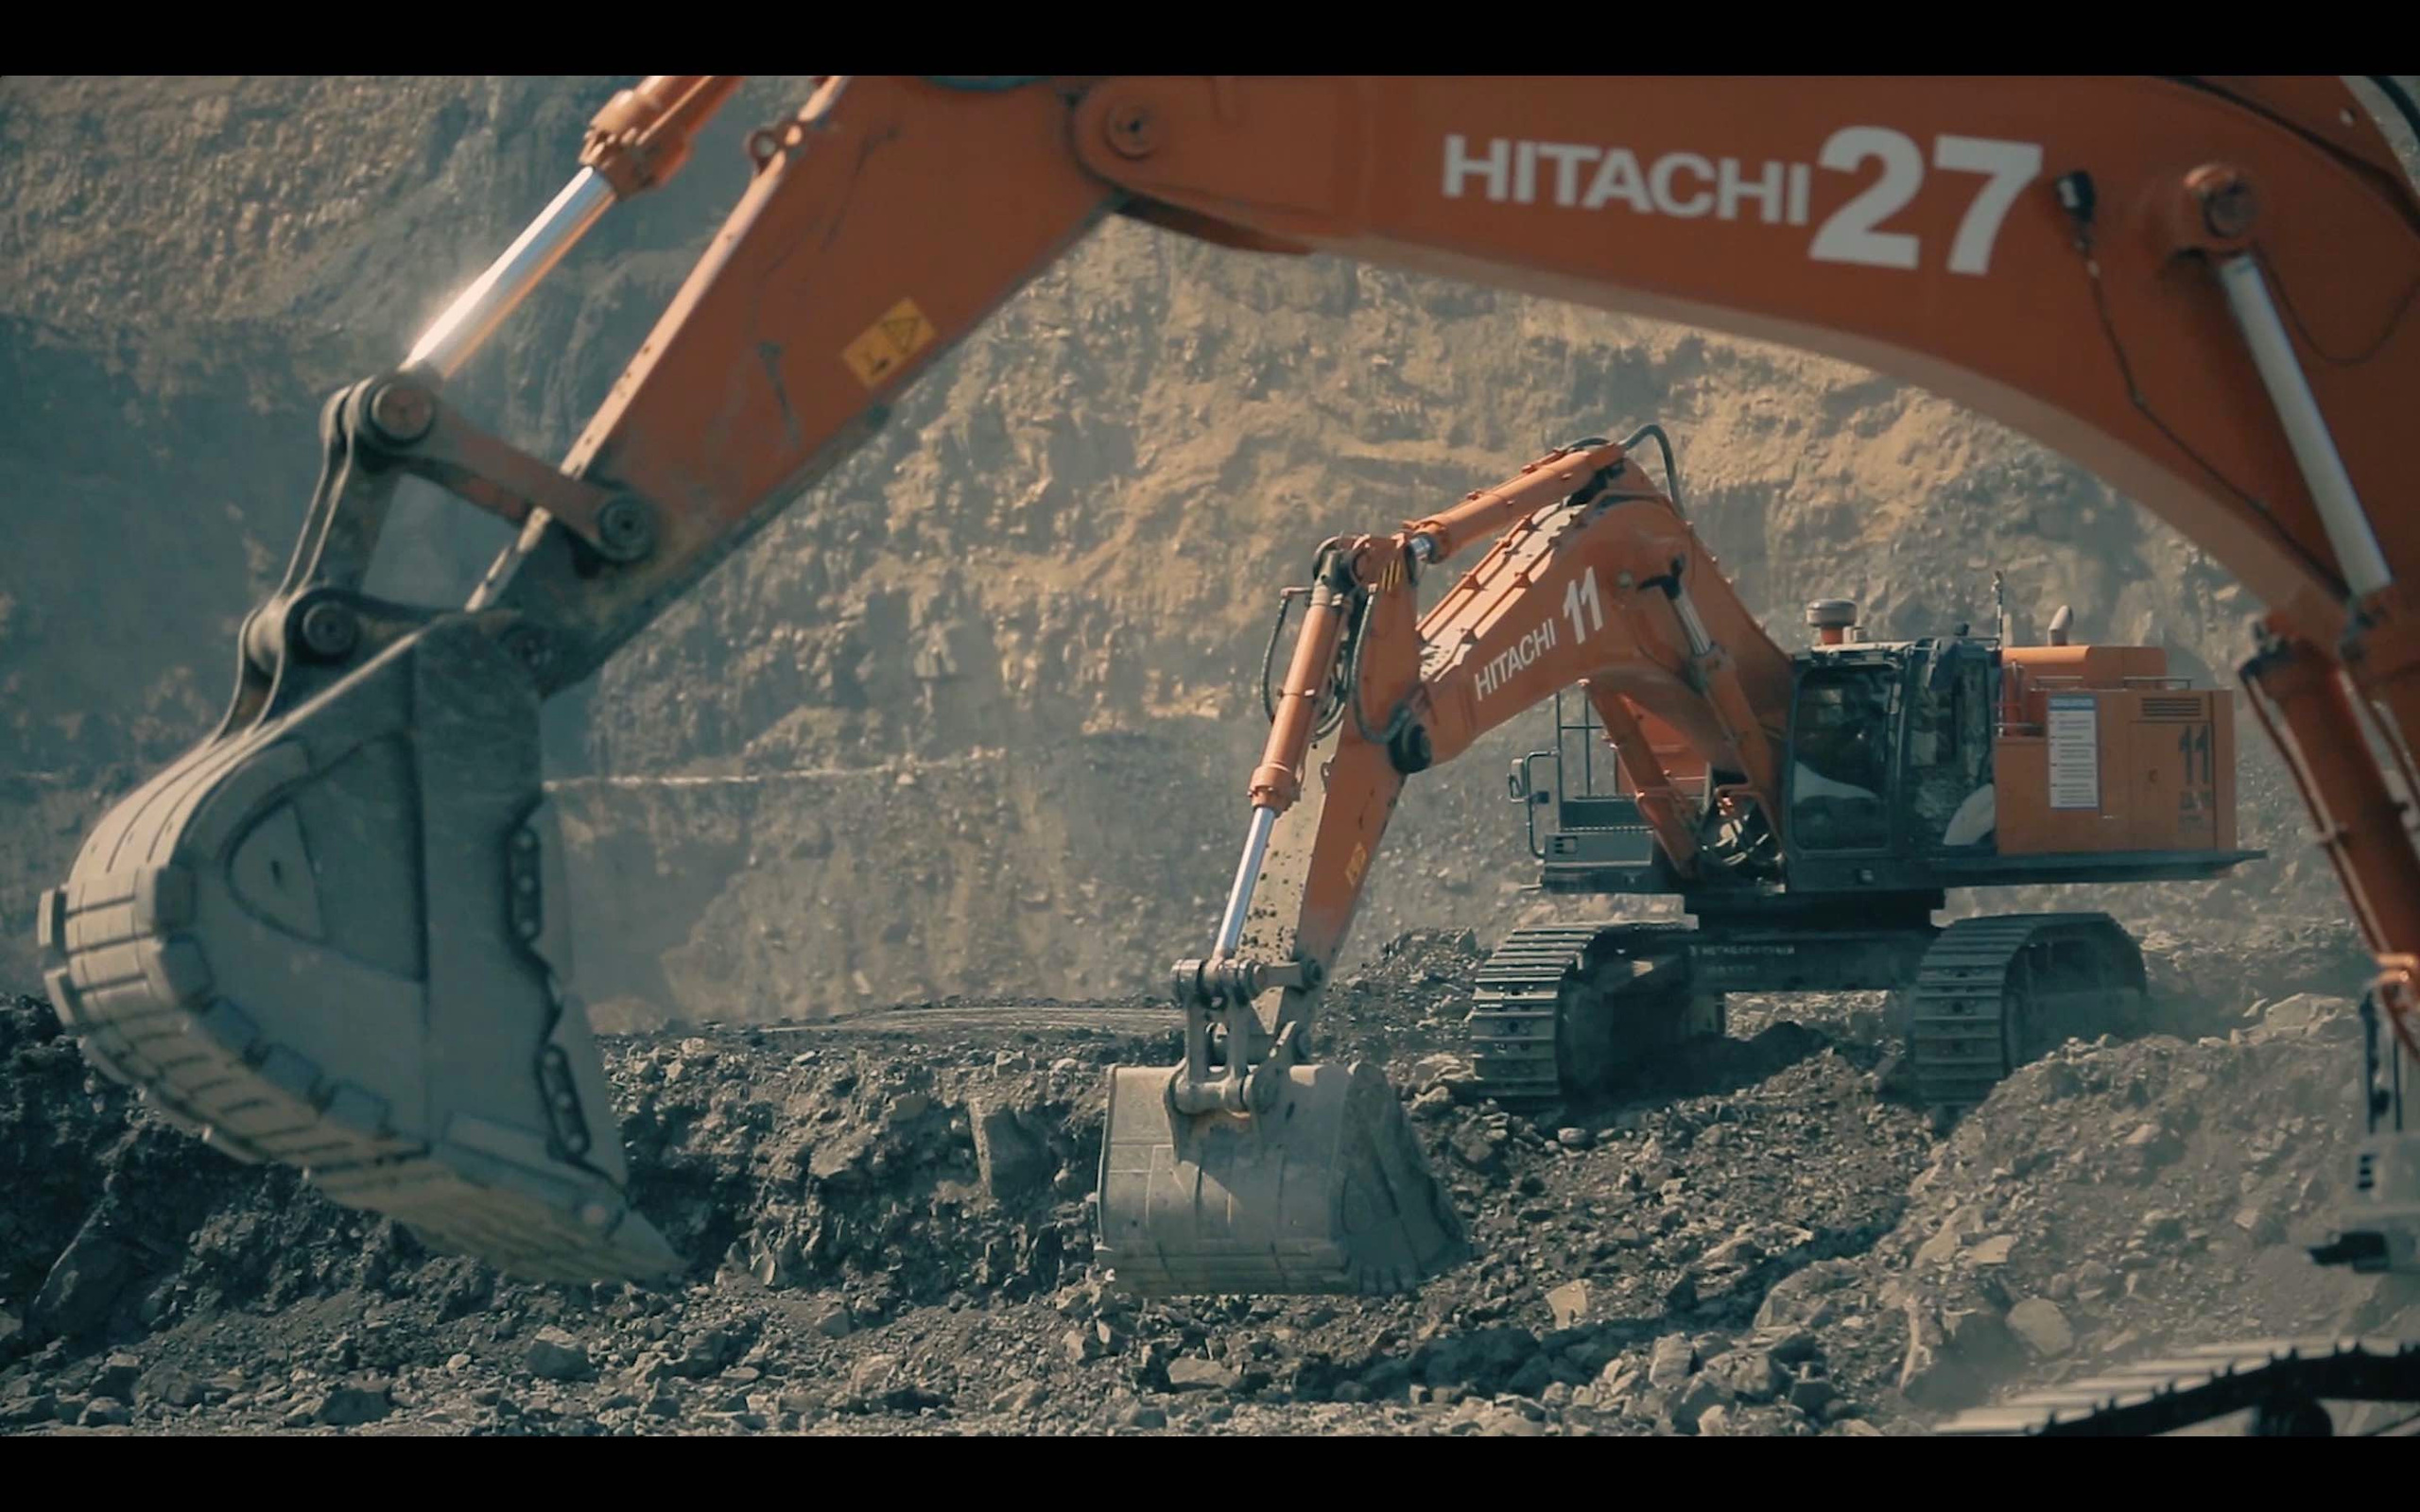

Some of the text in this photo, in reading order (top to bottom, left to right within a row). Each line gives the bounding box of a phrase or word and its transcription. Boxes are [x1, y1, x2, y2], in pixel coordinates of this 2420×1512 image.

[1442, 125, 2043, 276] HITACHI 27
[1475, 566, 1603, 700] HITACHI 11
